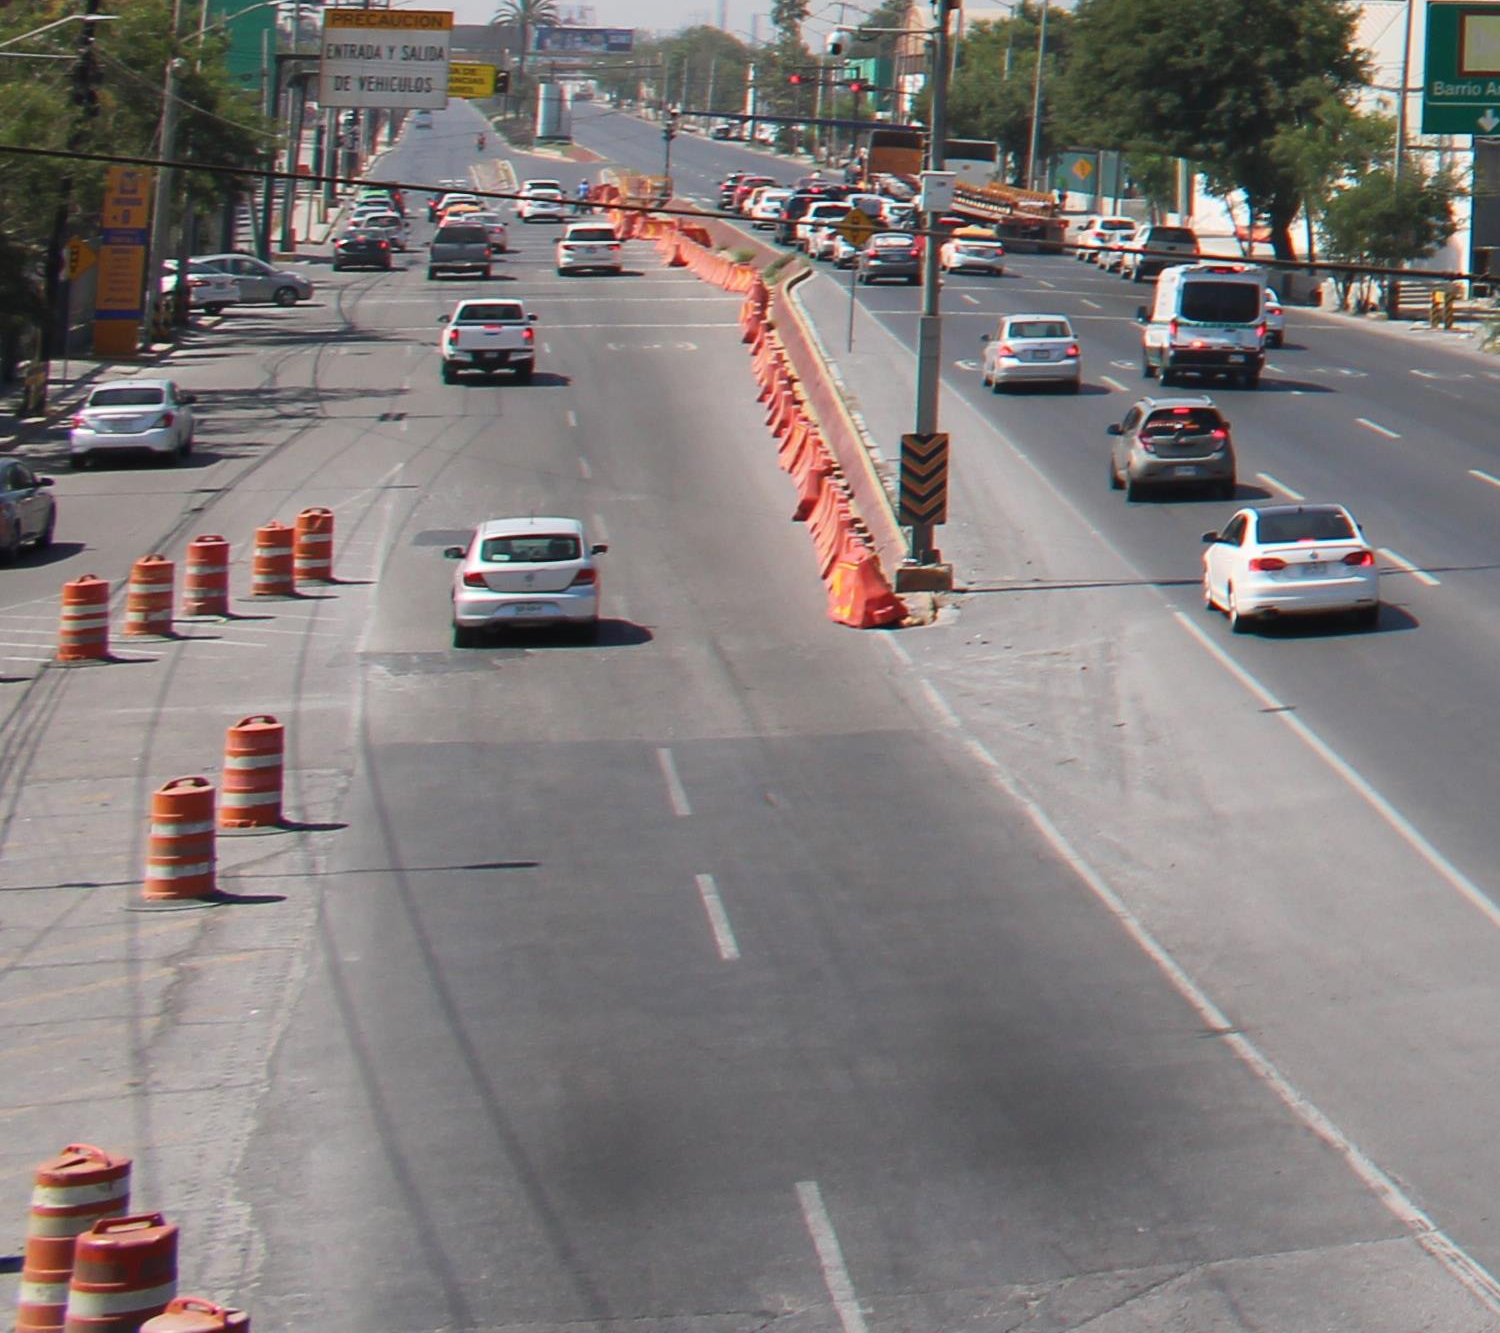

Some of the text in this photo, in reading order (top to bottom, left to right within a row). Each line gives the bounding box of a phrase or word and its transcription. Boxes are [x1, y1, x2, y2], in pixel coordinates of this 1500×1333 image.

[326, 43, 445, 61] ENTRADA Y SALIDA
[334, 76, 350, 91] DE
[357, 76, 432, 93] VEHICULOS
[1433, 81, 1481, 95] Barrio
